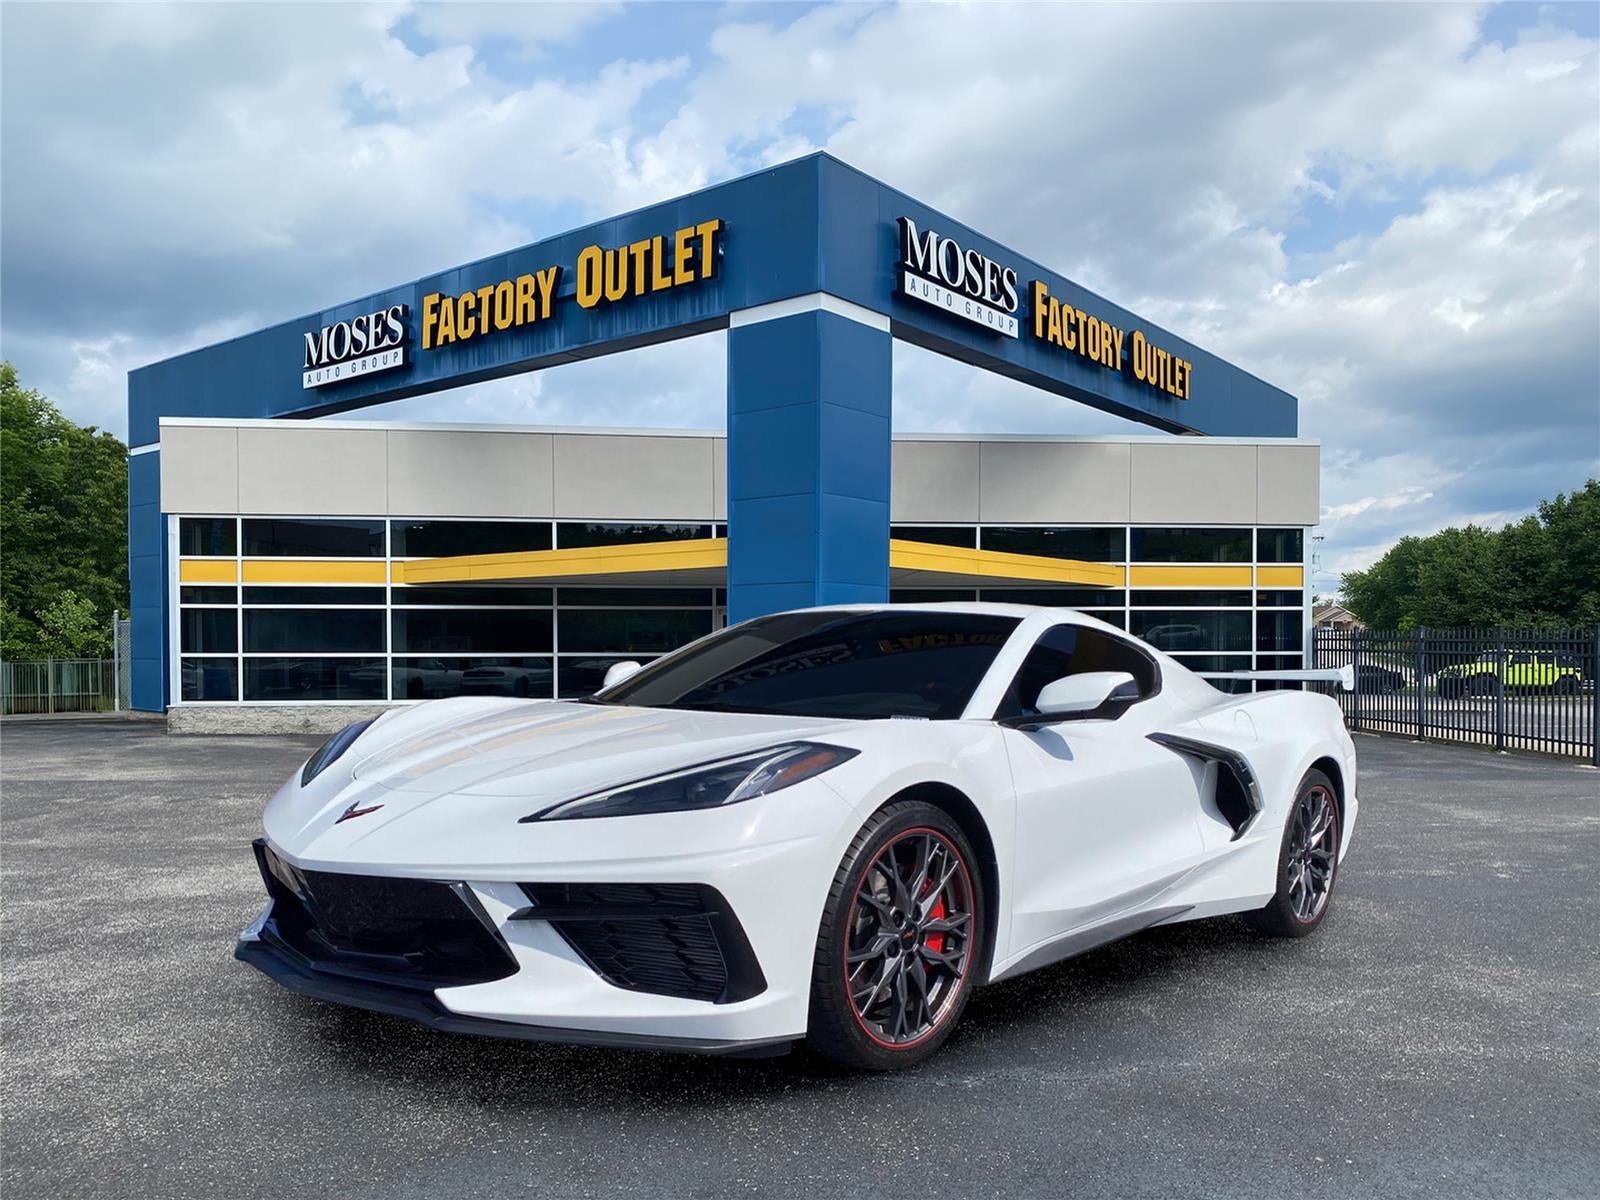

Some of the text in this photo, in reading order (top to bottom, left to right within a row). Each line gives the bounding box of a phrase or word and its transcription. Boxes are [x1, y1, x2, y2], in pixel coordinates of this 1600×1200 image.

[422, 219, 719, 349] FACTORY OUTLET
[904, 217, 1018, 312] MOSES
[303, 304, 404, 367] MOSES
[910, 279, 1015, 331] AUTO GROUP
[1035, 279, 1192, 399] FACTORY OUTLET
[307, 351, 399, 384] AUTO GROUP
